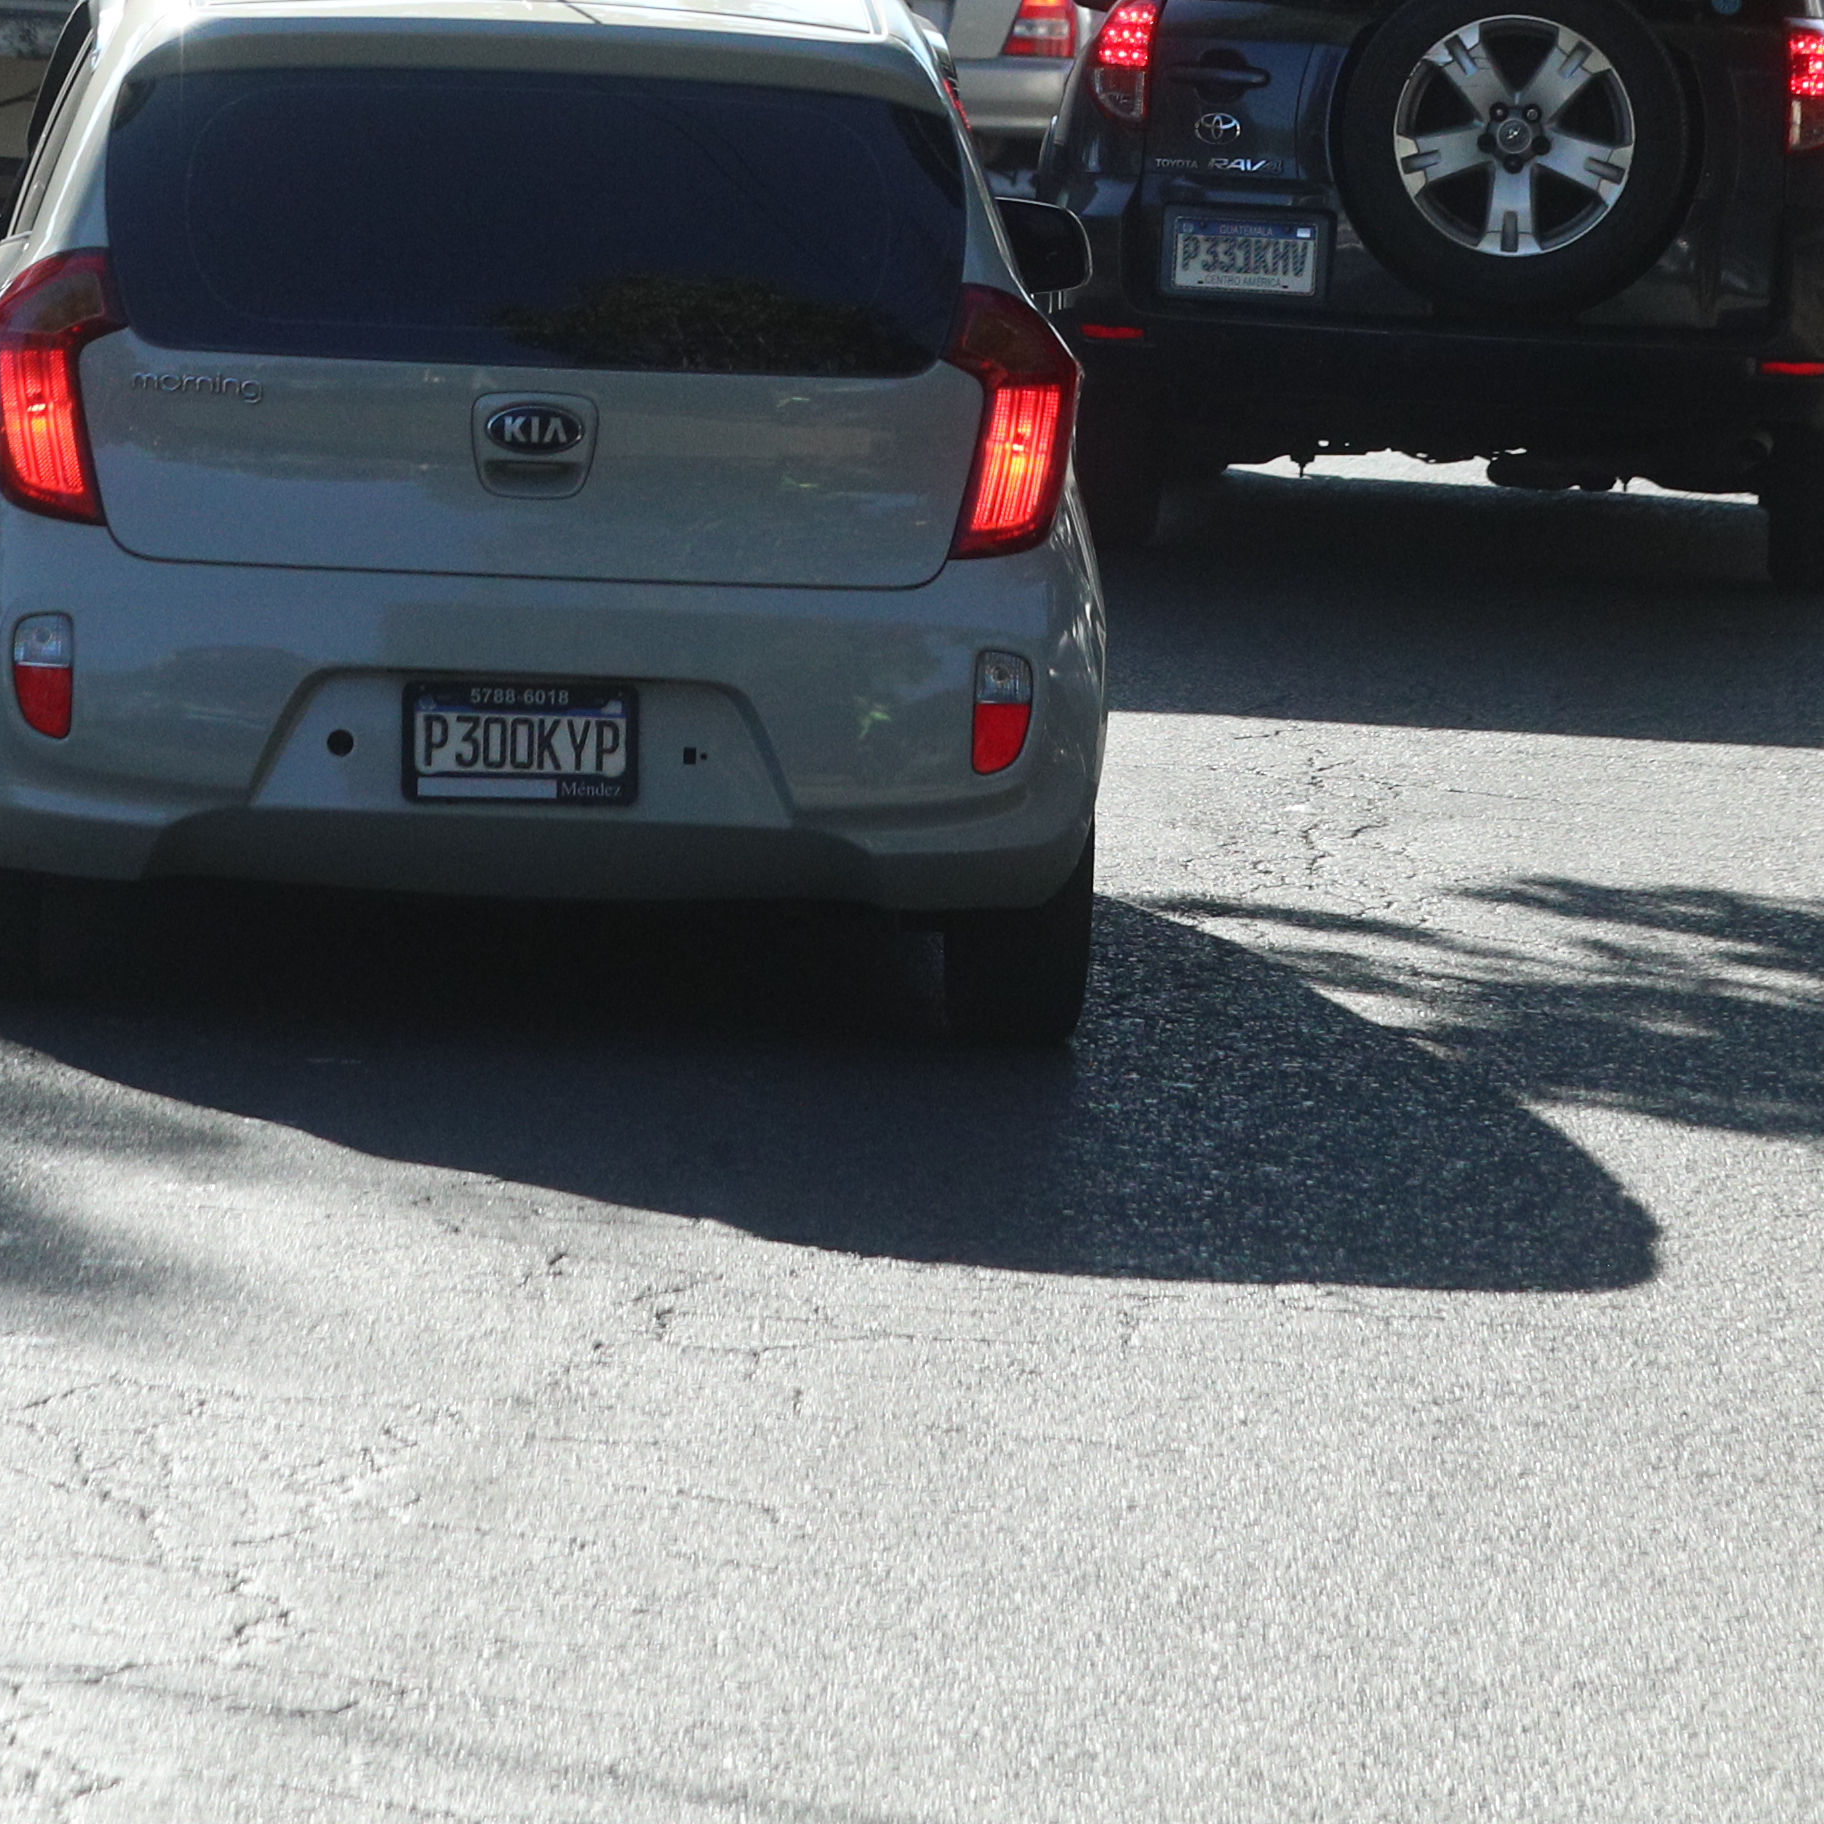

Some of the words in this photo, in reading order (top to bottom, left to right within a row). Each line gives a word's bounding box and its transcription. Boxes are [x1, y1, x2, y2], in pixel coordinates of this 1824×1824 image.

[1155, 158, 1198, 169] TOYOTA
[1208, 157, 1284, 174] RAV4
[1219, 225, 1273, 237] GUATEMALA
[1204, 274, 1241, 286] CENTRO
[132, 372, 263, 404] morning
[504, 416, 567, 443] KIA
[423, 714, 620, 772] P300KYP
[561, 781, 622, 797] Méndez
